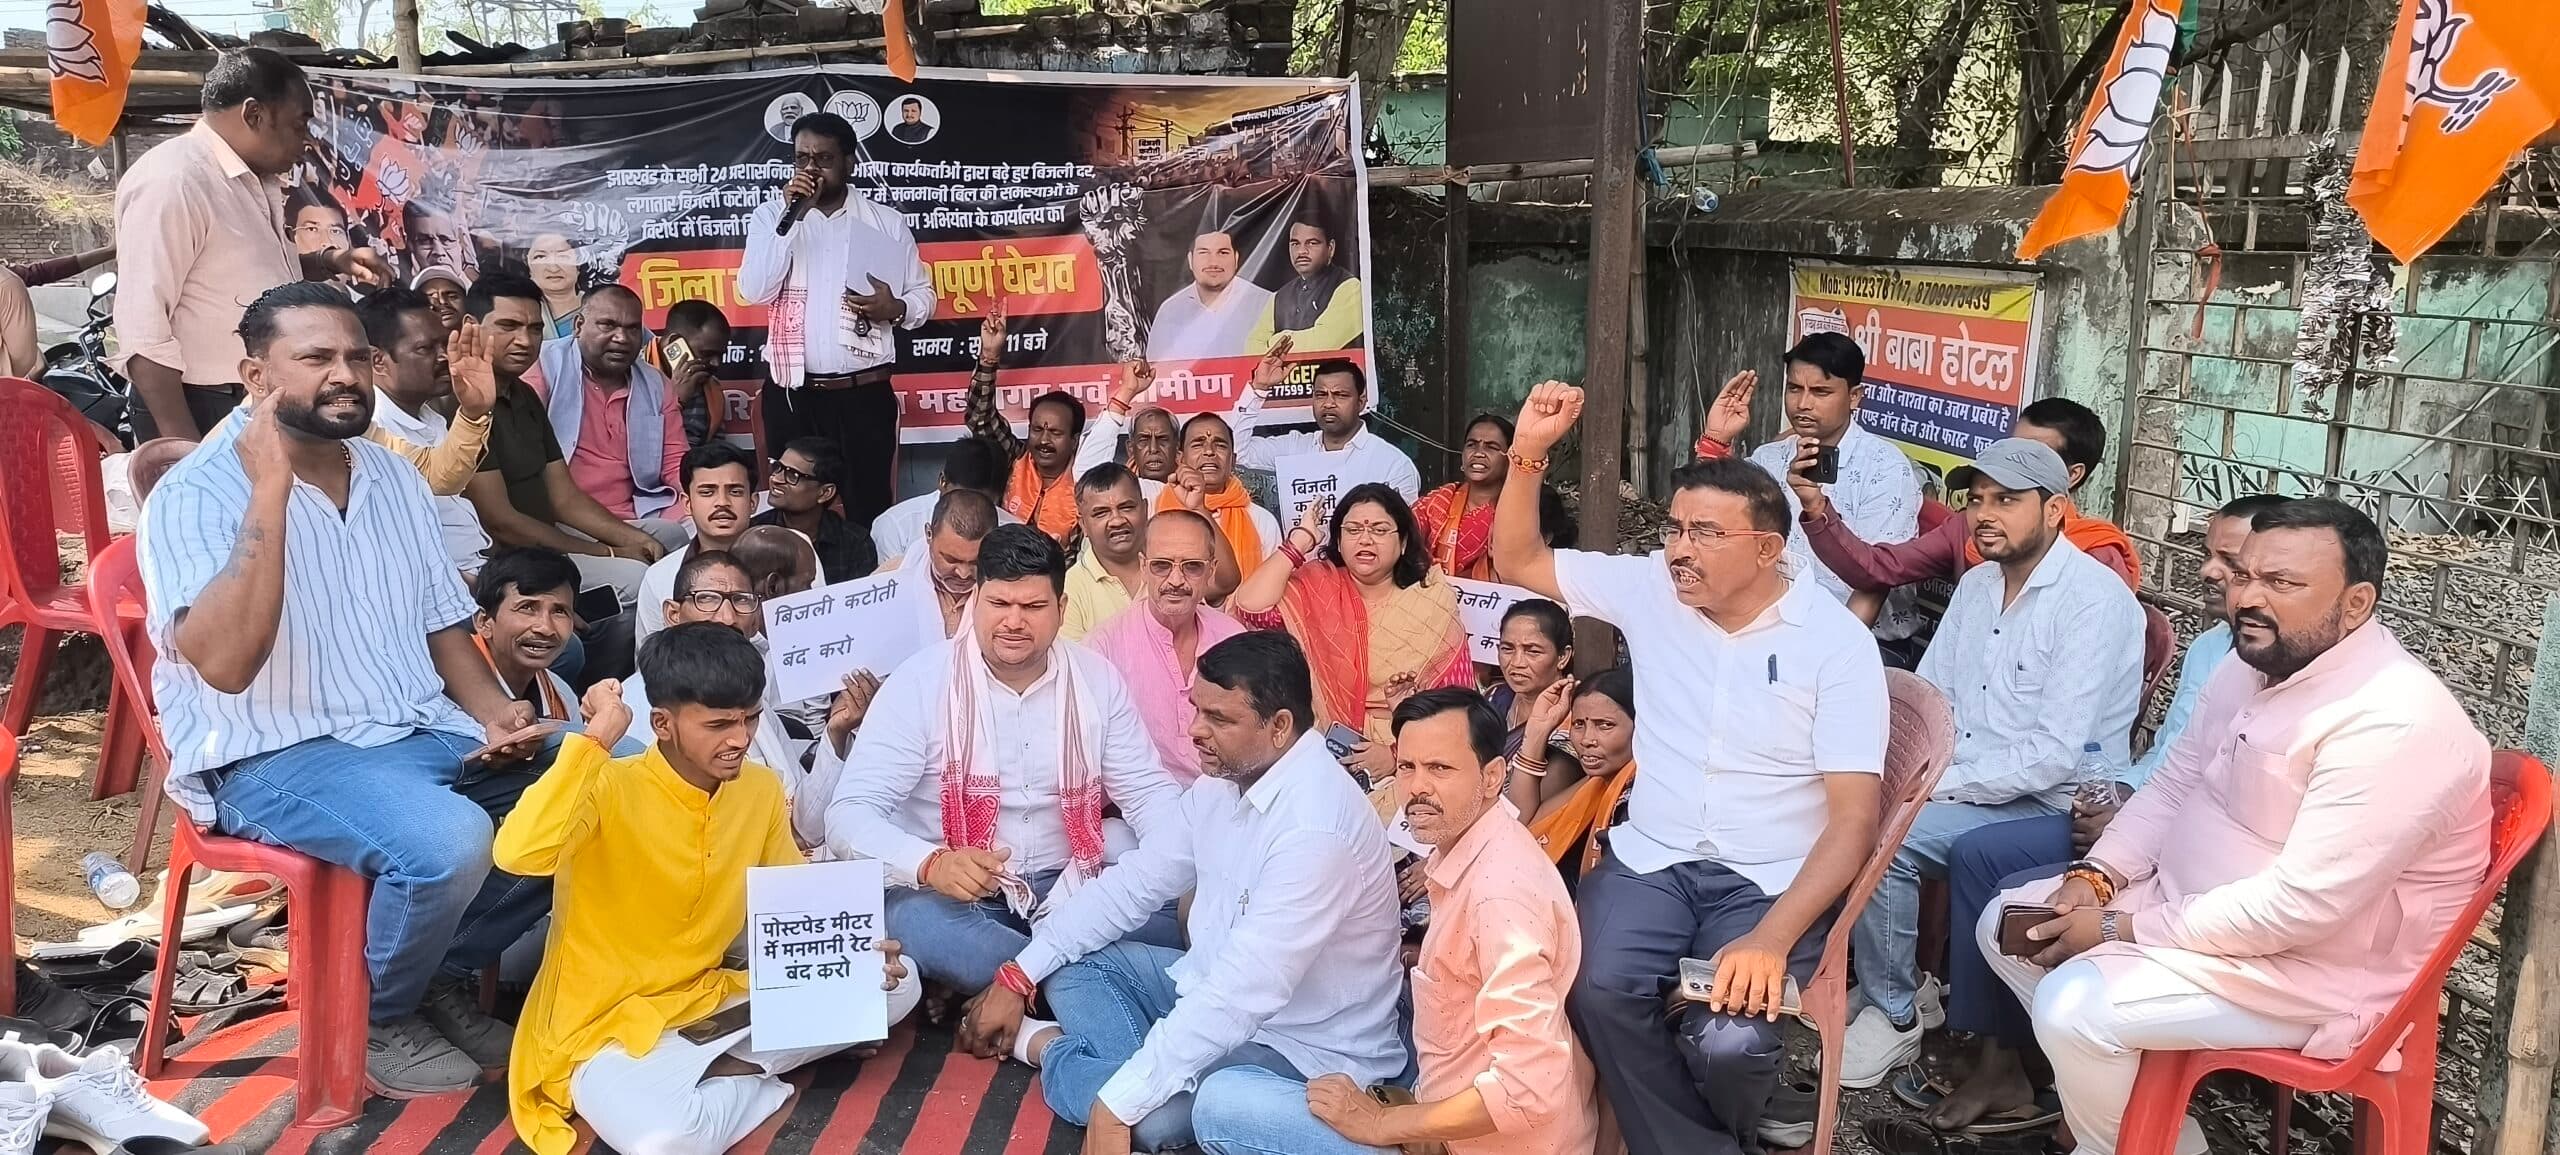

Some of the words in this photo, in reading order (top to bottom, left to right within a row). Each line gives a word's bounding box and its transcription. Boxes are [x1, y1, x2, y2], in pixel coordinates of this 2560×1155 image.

[606, 165, 658, 187] झारखंड
[659, 164, 674, 184] के
[676, 163, 708, 184] सभी
[710, 166, 727, 183] 24
[728, 159, 796, 180] प्रशासनिक
[891, 158, 961, 180] कार्यकर्ताओं
[963, 164, 990, 183] द्वारा
[992, 163, 1010, 184] बढ़े
[1011, 164, 1030, 183] हुए
[1031, 161, 1075, 180] बिजली
[626, 195, 678, 214] लगातार
[678, 188, 721, 210] बिजली
[722, 185, 760, 208] कटौती
[891, 183, 947, 206] मनमानी
[948, 184, 977, 203] बिल
[980, 183, 998, 202] की
[999, 182, 1064, 202] समस्याओं
[1064, 183, 1081, 197] के
[642, 218, 679, 240] विरोध
[680, 216, 696, 238] में
[696, 213, 740, 237] बिजली
[922, 204, 973, 230] अभियंता
[973, 208, 989, 228] के
[990, 203, 1045, 227] कार्यालय
[1045, 205, 1066, 224] का
[996, 244, 1077, 296] घेराव
[1819, 272, 1842, 294] Mob:
[637, 258, 726, 311] जिला
[912, 337, 954, 357] समय
[1023, 327, 1049, 352] बजे
[1854, 308, 1882, 366] श्री
[1885, 329, 1937, 378] बाबा
[1940, 321, 2019, 392] होटल
[1877, 383, 1897, 404] और
[1898, 389, 1928, 412] नाश्ता
[1928, 397, 1944, 417] का
[1945, 398, 1972, 420] उत्तम
[1972, 403, 2000, 427] प्रबंध
[2000, 406, 2011, 432] है
[1862, 409, 1880, 427] एण्ड
[1880, 410, 1900, 432] नॉन
[1901, 414, 1919, 436] वेज
[1918, 419, 1940, 442] और
[1941, 428, 1970, 449] फास्ट
[1291, 474, 1338, 496] बिजली
[775, 594, 835, 626] बिजली
[782, 645, 810, 667] बंद
[819, 634, 855, 658] करो
[761, 915, 827, 937] पोस्टपेड
[830, 911, 874, 931] मीटर
[764, 940, 779, 959] में
[782, 934, 844, 957] मनमानी
[849, 933, 872, 952] रेट
[817, 955, 851, 980] करो
